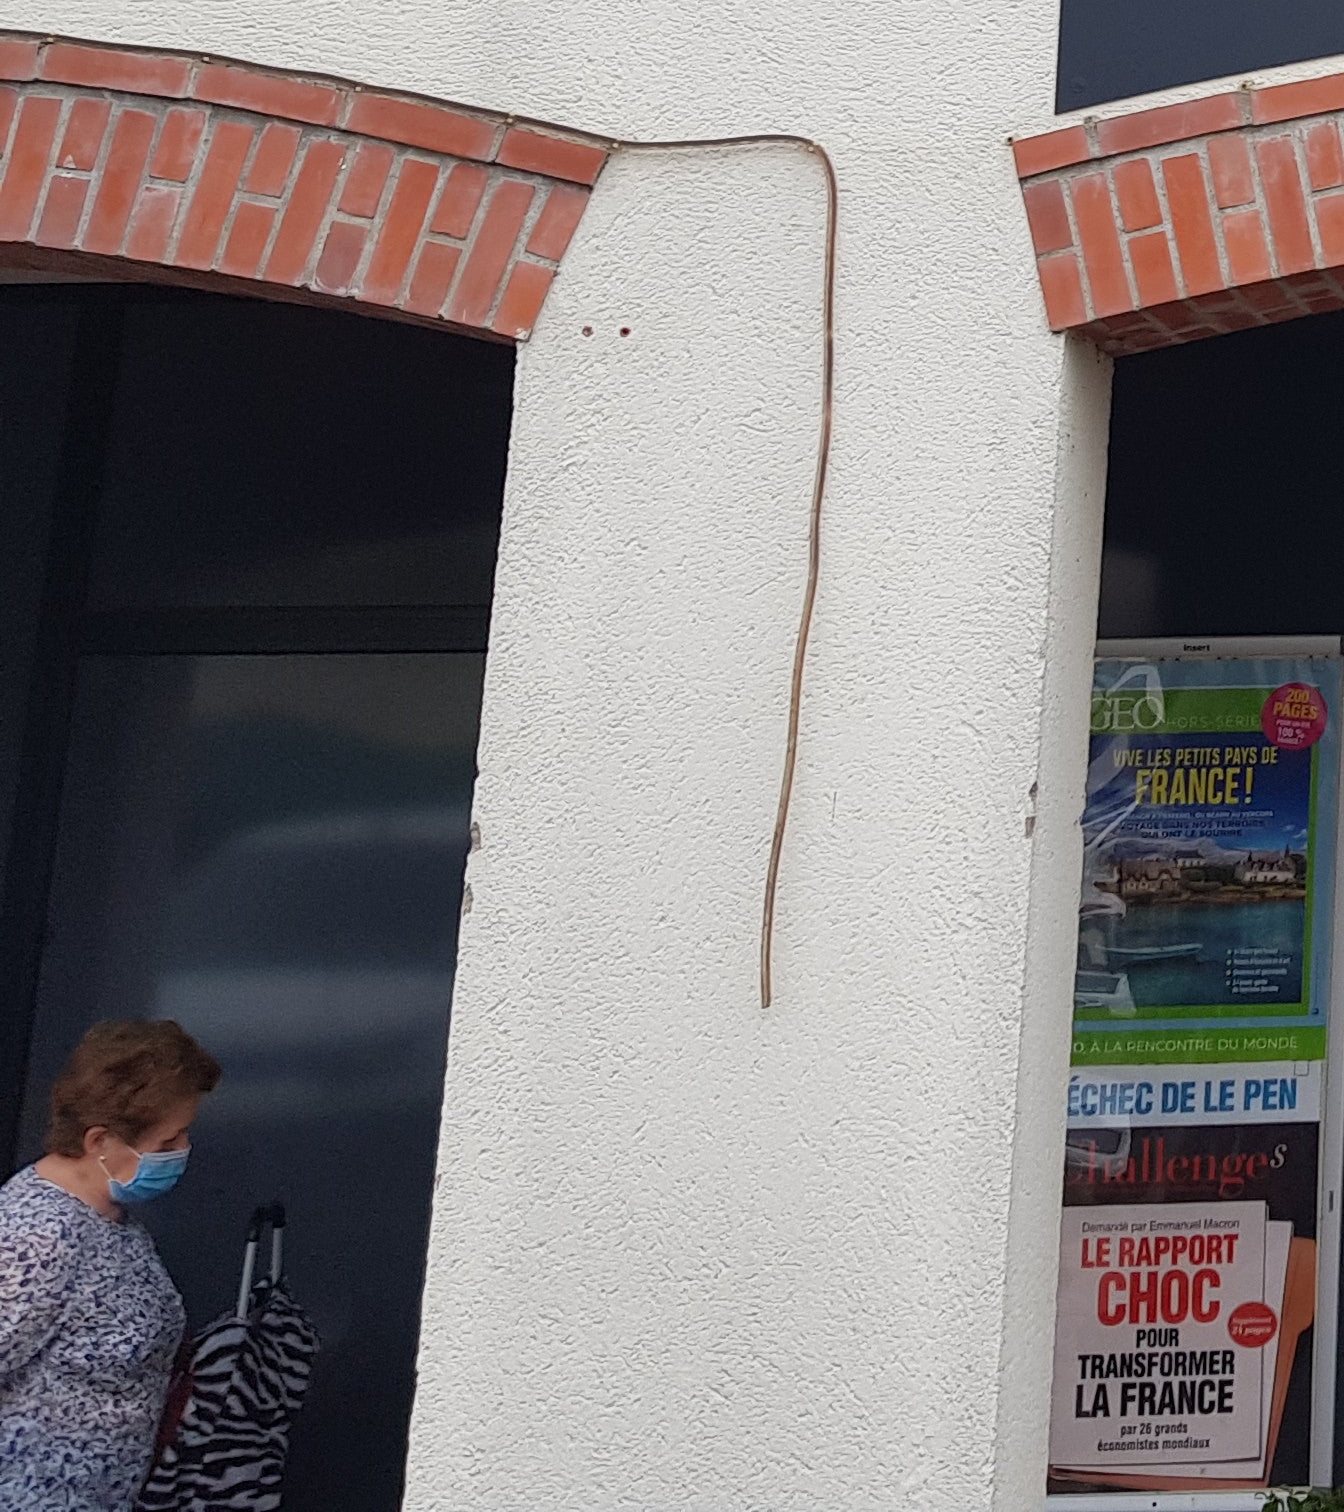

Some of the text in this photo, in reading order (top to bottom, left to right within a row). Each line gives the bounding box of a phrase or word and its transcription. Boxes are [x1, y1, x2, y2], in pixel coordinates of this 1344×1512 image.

[1286, 688, 1310, 703] 200
[1272, 701, 1319, 720] PAGES
[1112, 746, 1279, 767] VIVE LES PETITS PAYS DE
[1126, 1038, 1213, 1053] RENCONTRE
[1218, 1038, 1239, 1050] DU
[1243, 1037, 1298, 1050] MONDE
[1160, 1081, 1195, 1114] DE
[1203, 1080, 1236, 1113] LE
[1243, 1078, 1298, 1111] PEN
[1131, 1222, 1147, 1234] par
[1149, 1219, 1202, 1232] Emmanuel
[1203, 1218, 1240, 1230] Macron
[1080, 1233, 1239, 1268] LE RAPPORT
[1097, 1268, 1221, 1326] CHOC
[1135, 1328, 1179, 1349] POUR
[1077, 1350, 1236, 1380] TRANSFORMER
[1075, 1378, 1234, 1419] LA FRANCE
[1120, 1422, 1188, 1437] par 26 grands
[1096, 1436, 1211, 1452] économistes mondiaux
